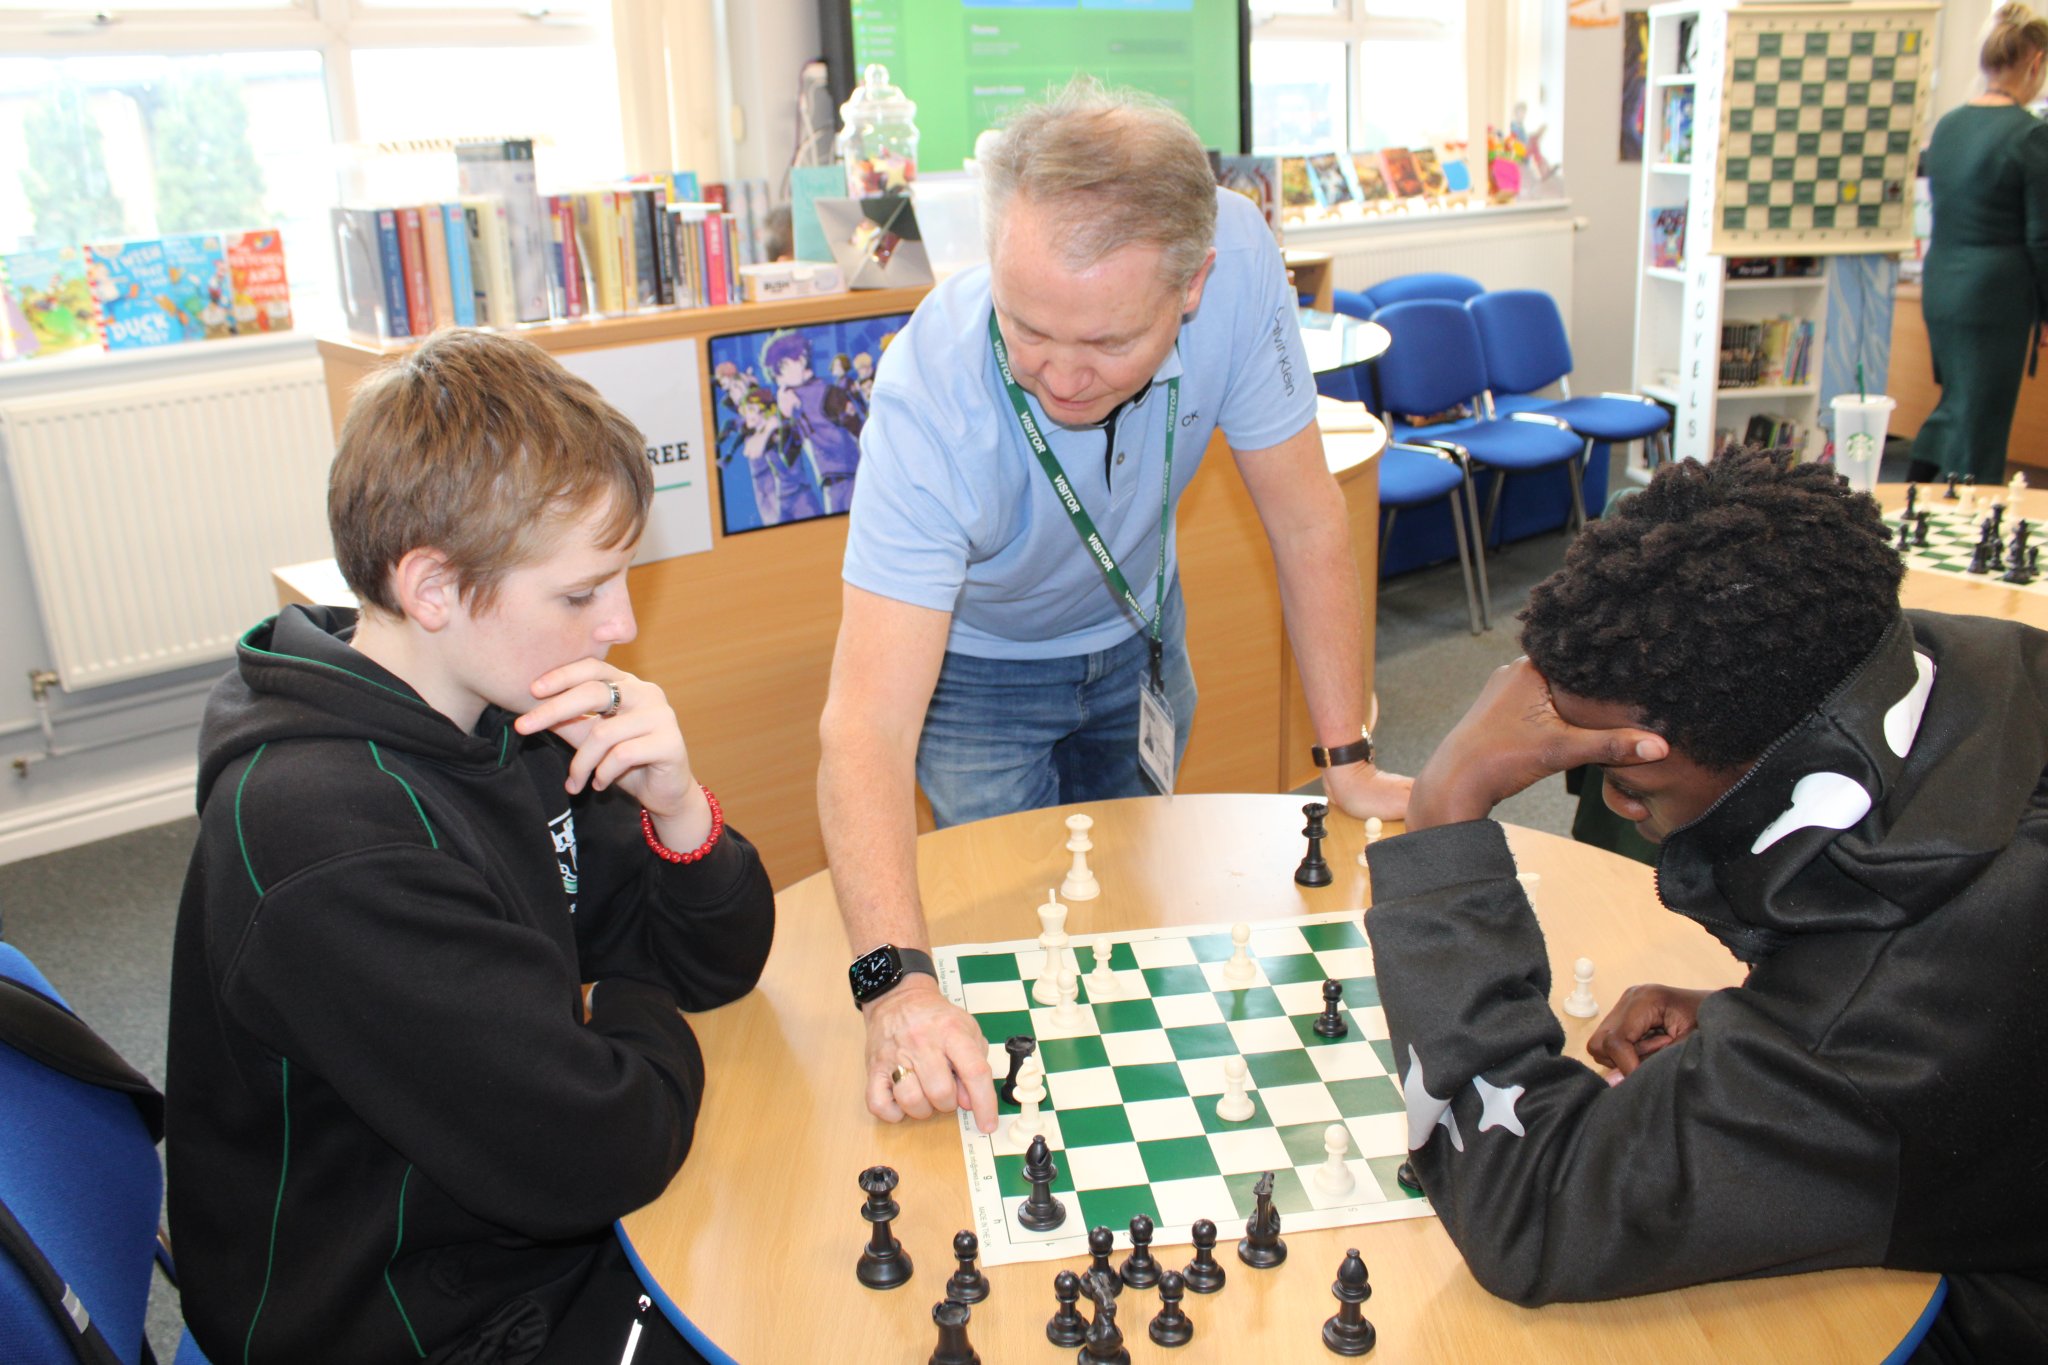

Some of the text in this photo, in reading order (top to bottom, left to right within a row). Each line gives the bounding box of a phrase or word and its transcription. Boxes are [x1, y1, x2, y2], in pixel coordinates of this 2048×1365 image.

[110, 313, 169, 342] DUCK
[994, 340, 1015, 386] VISITOR
[1279, 355, 1295, 398] Klein
[1687, 272, 1707, 438] NOVELS
[1167, 388, 1178, 432] VISITOR
[1181, 410, 1199, 427] CK
[1020, 411, 1047, 454] VISITOR
[1054, 474, 1081, 515] VISITOR
[1088, 532, 1114, 573] VISITOR
